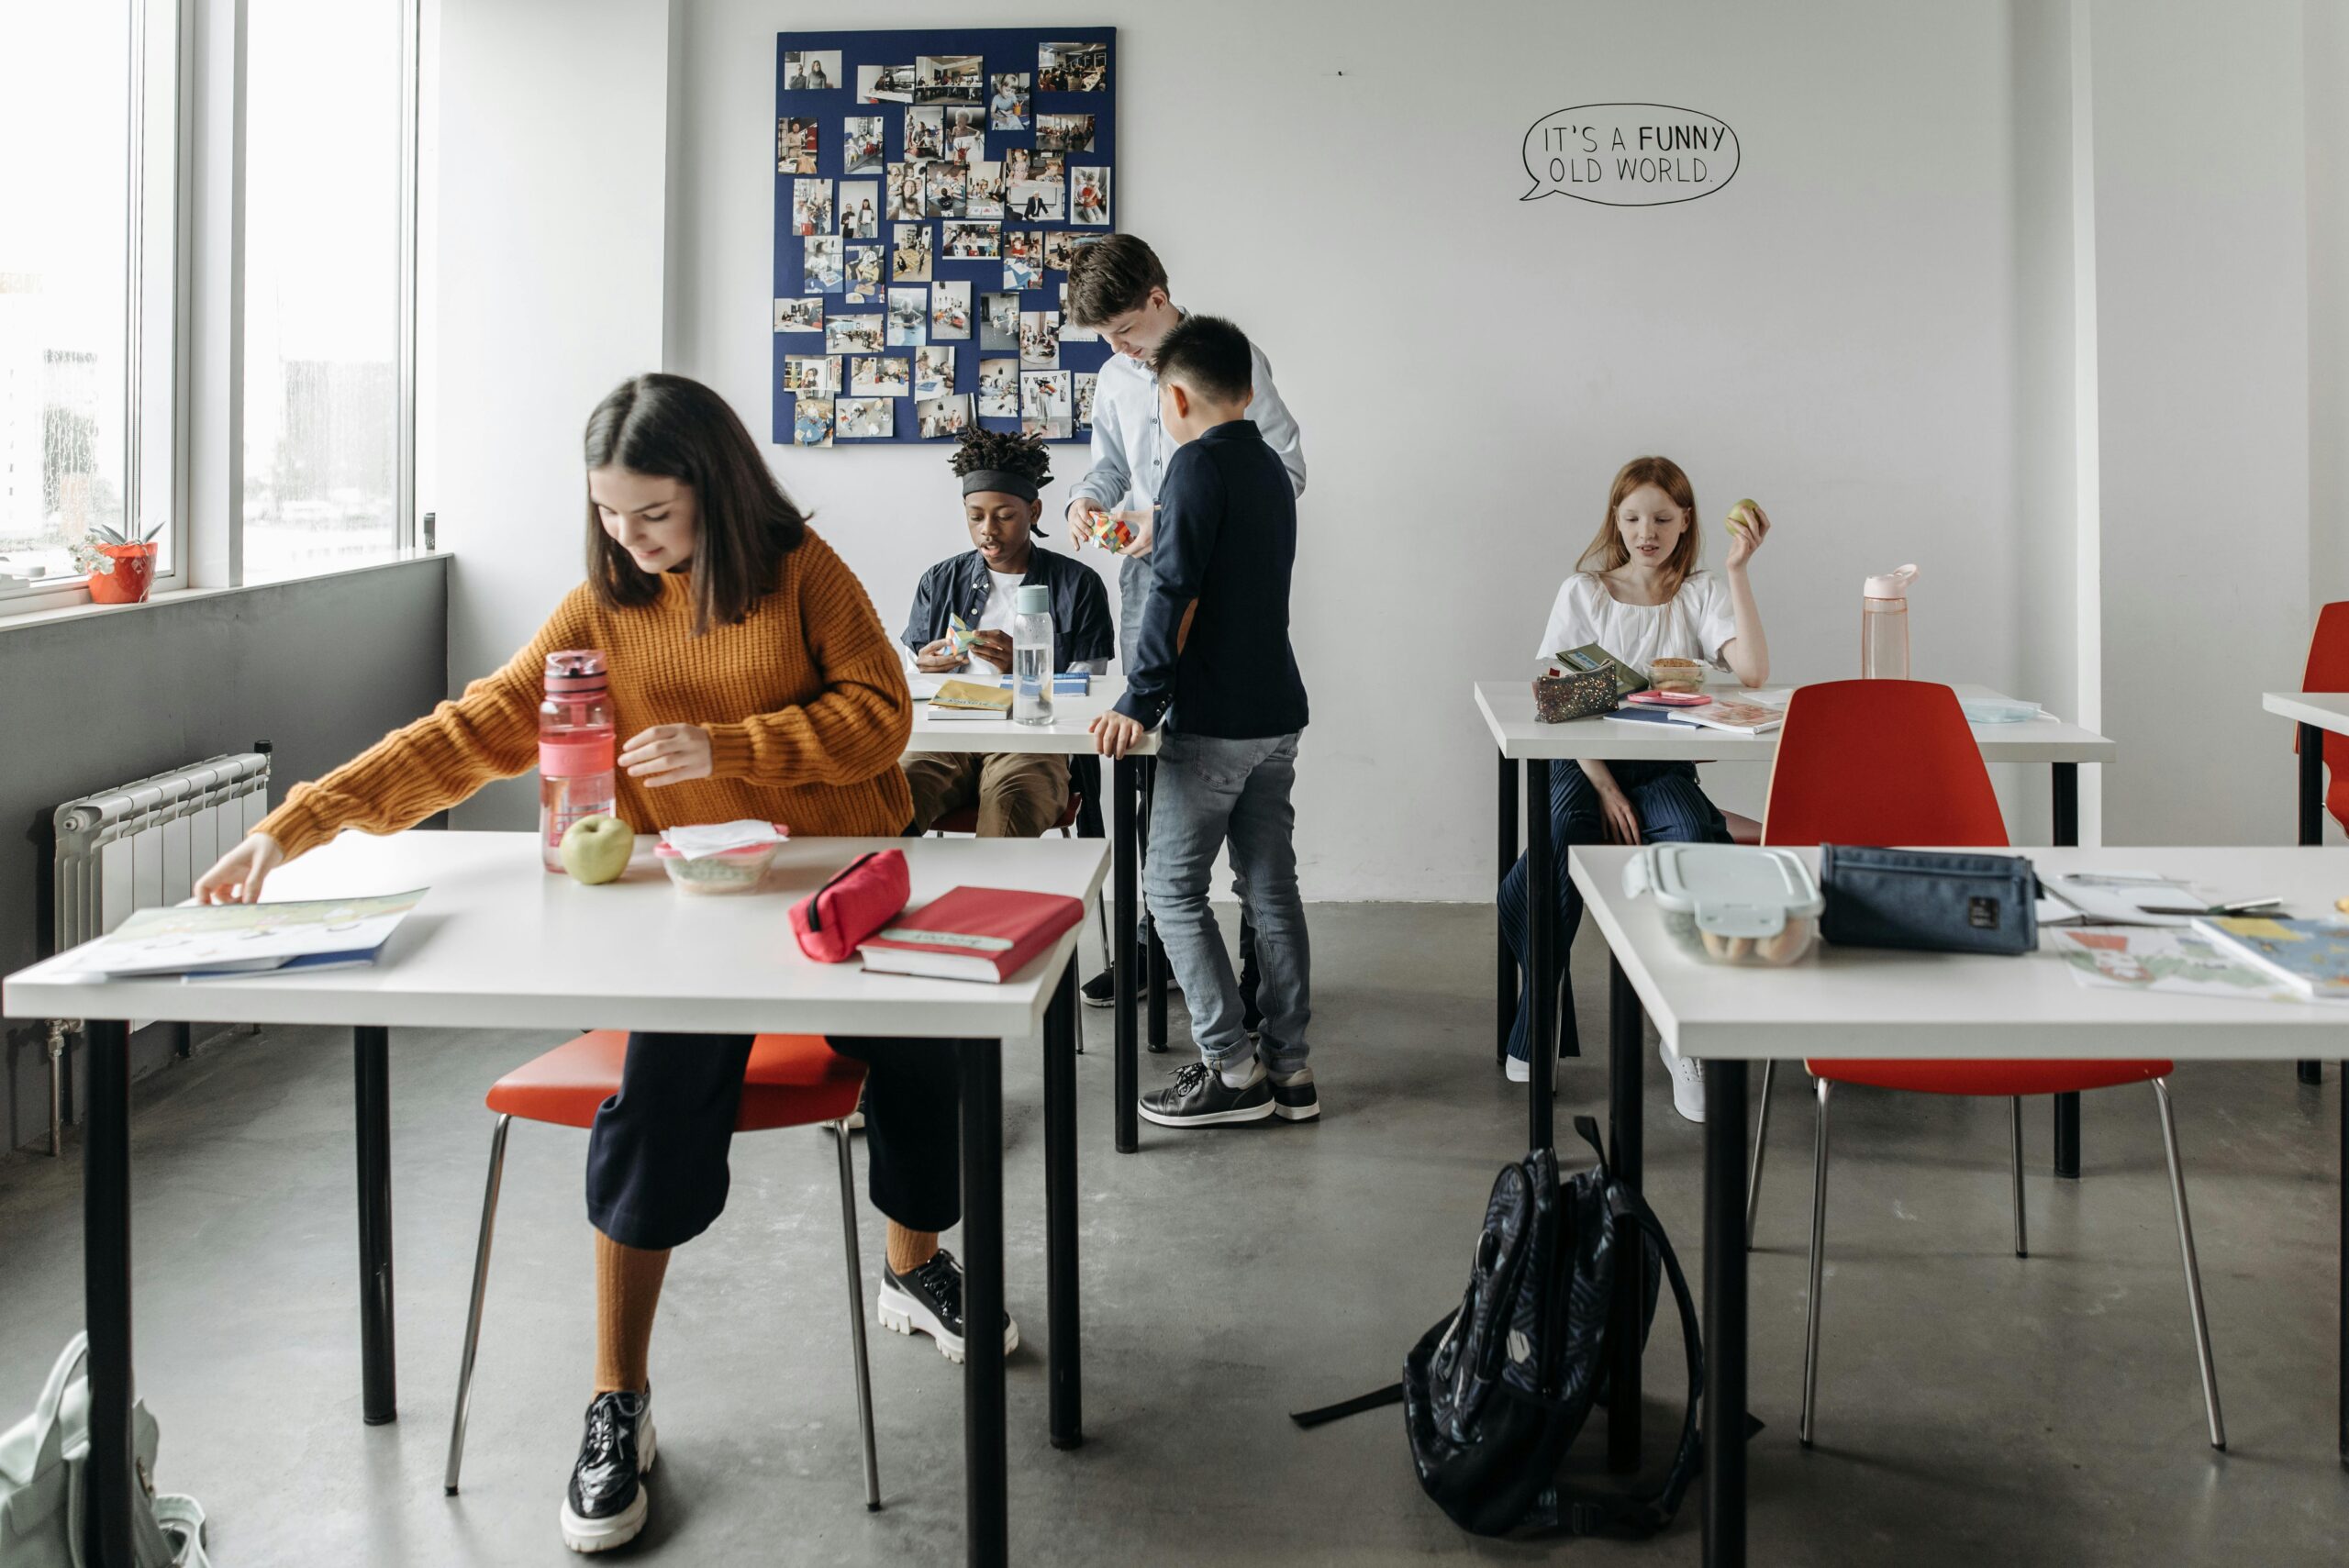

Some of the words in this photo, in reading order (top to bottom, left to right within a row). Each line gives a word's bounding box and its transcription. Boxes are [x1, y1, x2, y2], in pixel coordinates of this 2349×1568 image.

[1544, 125, 1598, 152] IT'S
[1611, 127, 1626, 151] A
[1639, 125, 1725, 151] FUNNY
[1549, 157, 1602, 183] OLD
[1616, 157, 1713, 183] WORLD.
